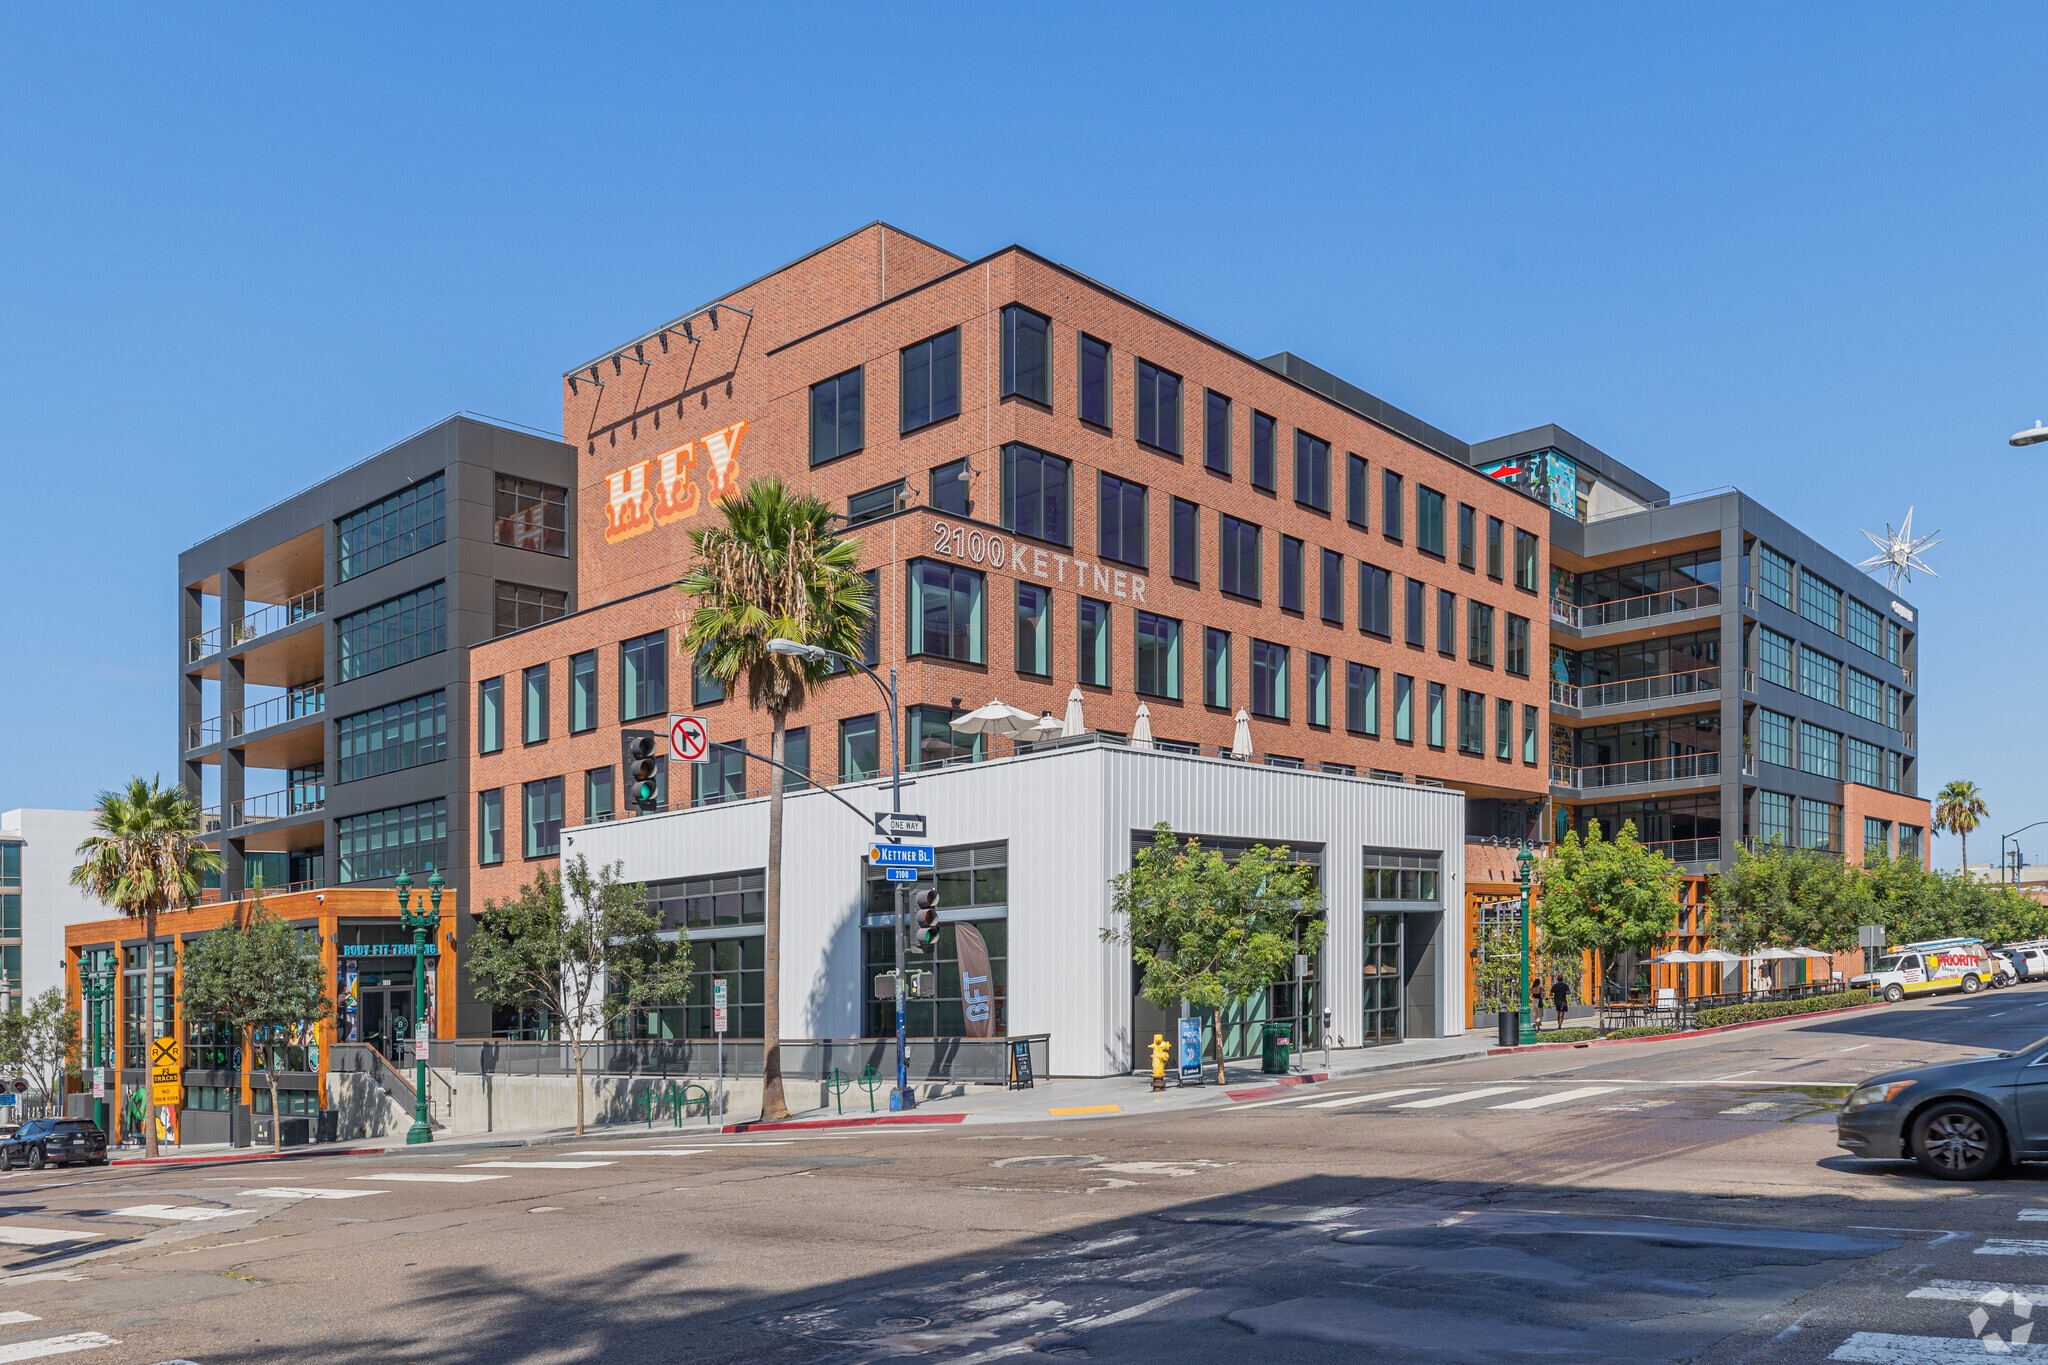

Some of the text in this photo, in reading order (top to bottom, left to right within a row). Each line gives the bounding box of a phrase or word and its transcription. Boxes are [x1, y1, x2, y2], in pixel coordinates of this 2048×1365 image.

[605, 419, 750, 545] HEY
[934, 521, 1146, 603] 2100 KETTNER
[890, 820, 920, 830] ONE WAY
[895, 870, 909, 879] 2100
[343, 944, 370, 956] BODY
[373, 944, 390, 956] FIT
[1937, 953, 1980, 967] PRIORITY
[962, 971, 990, 1022] BFT
[154, 1074, 178, 1082] TRACKS
